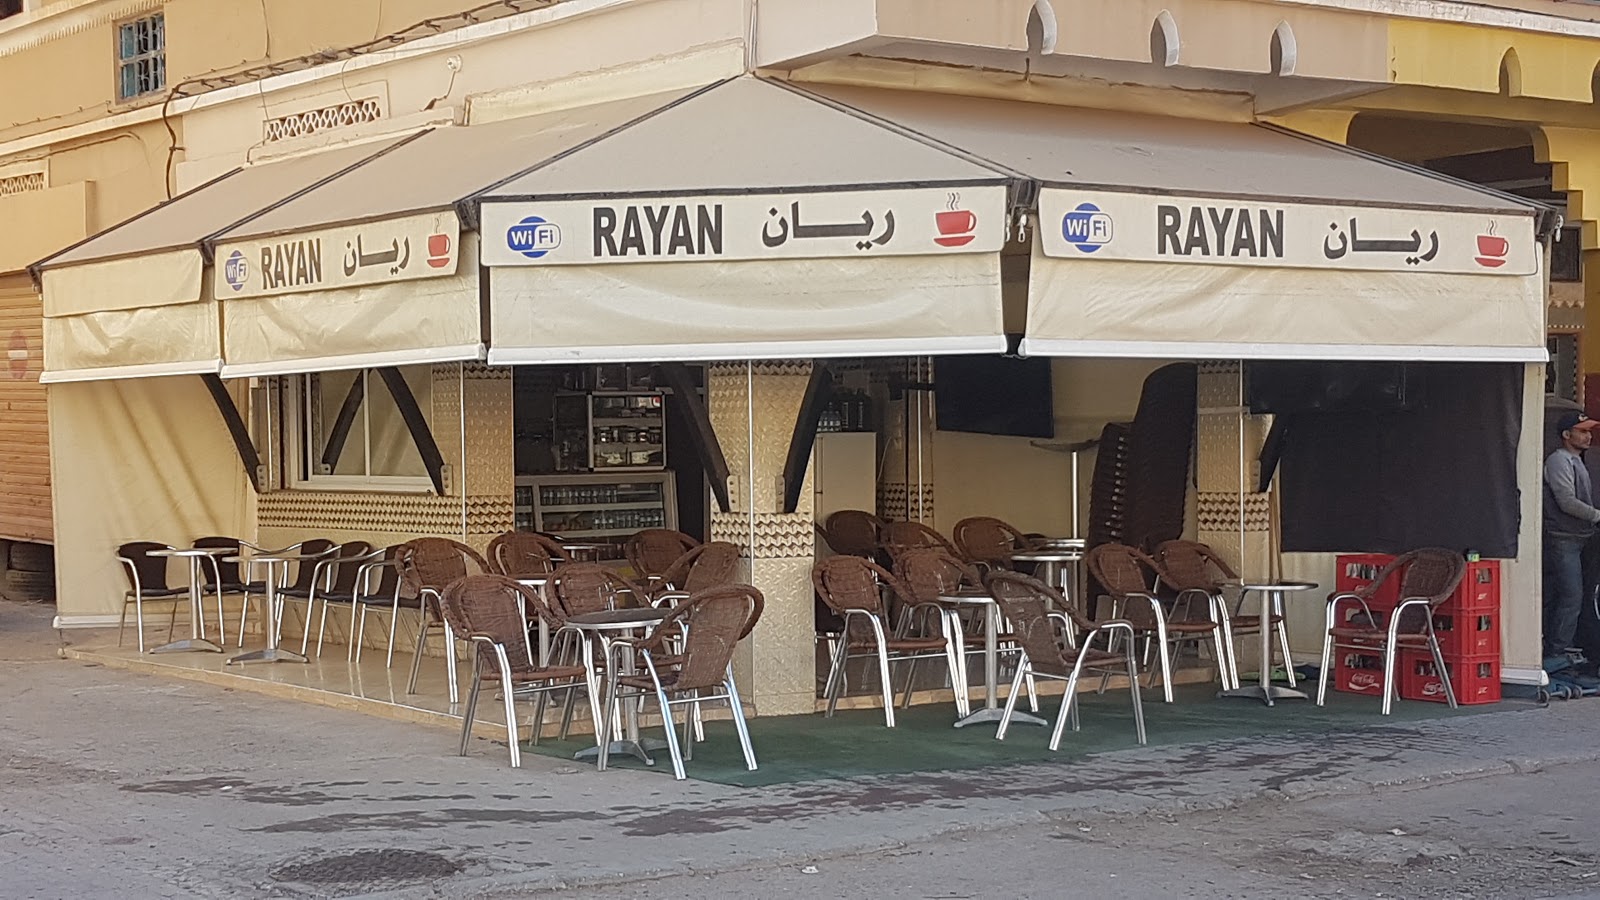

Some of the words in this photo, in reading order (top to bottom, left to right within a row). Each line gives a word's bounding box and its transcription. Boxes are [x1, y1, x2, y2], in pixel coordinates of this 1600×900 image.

[511, 224, 554, 247] WiFi
[593, 204, 723, 257] RAYAN
[762, 200, 895, 251] ريان
[1066, 218, 1108, 238] WiFi
[1157, 204, 1284, 258] RAYAN
[1323, 217, 1439, 266] ريان
[226, 262, 247, 281] WiFi
[260, 237, 323, 290] RAYAN
[343, 234, 410, 277] ريان
